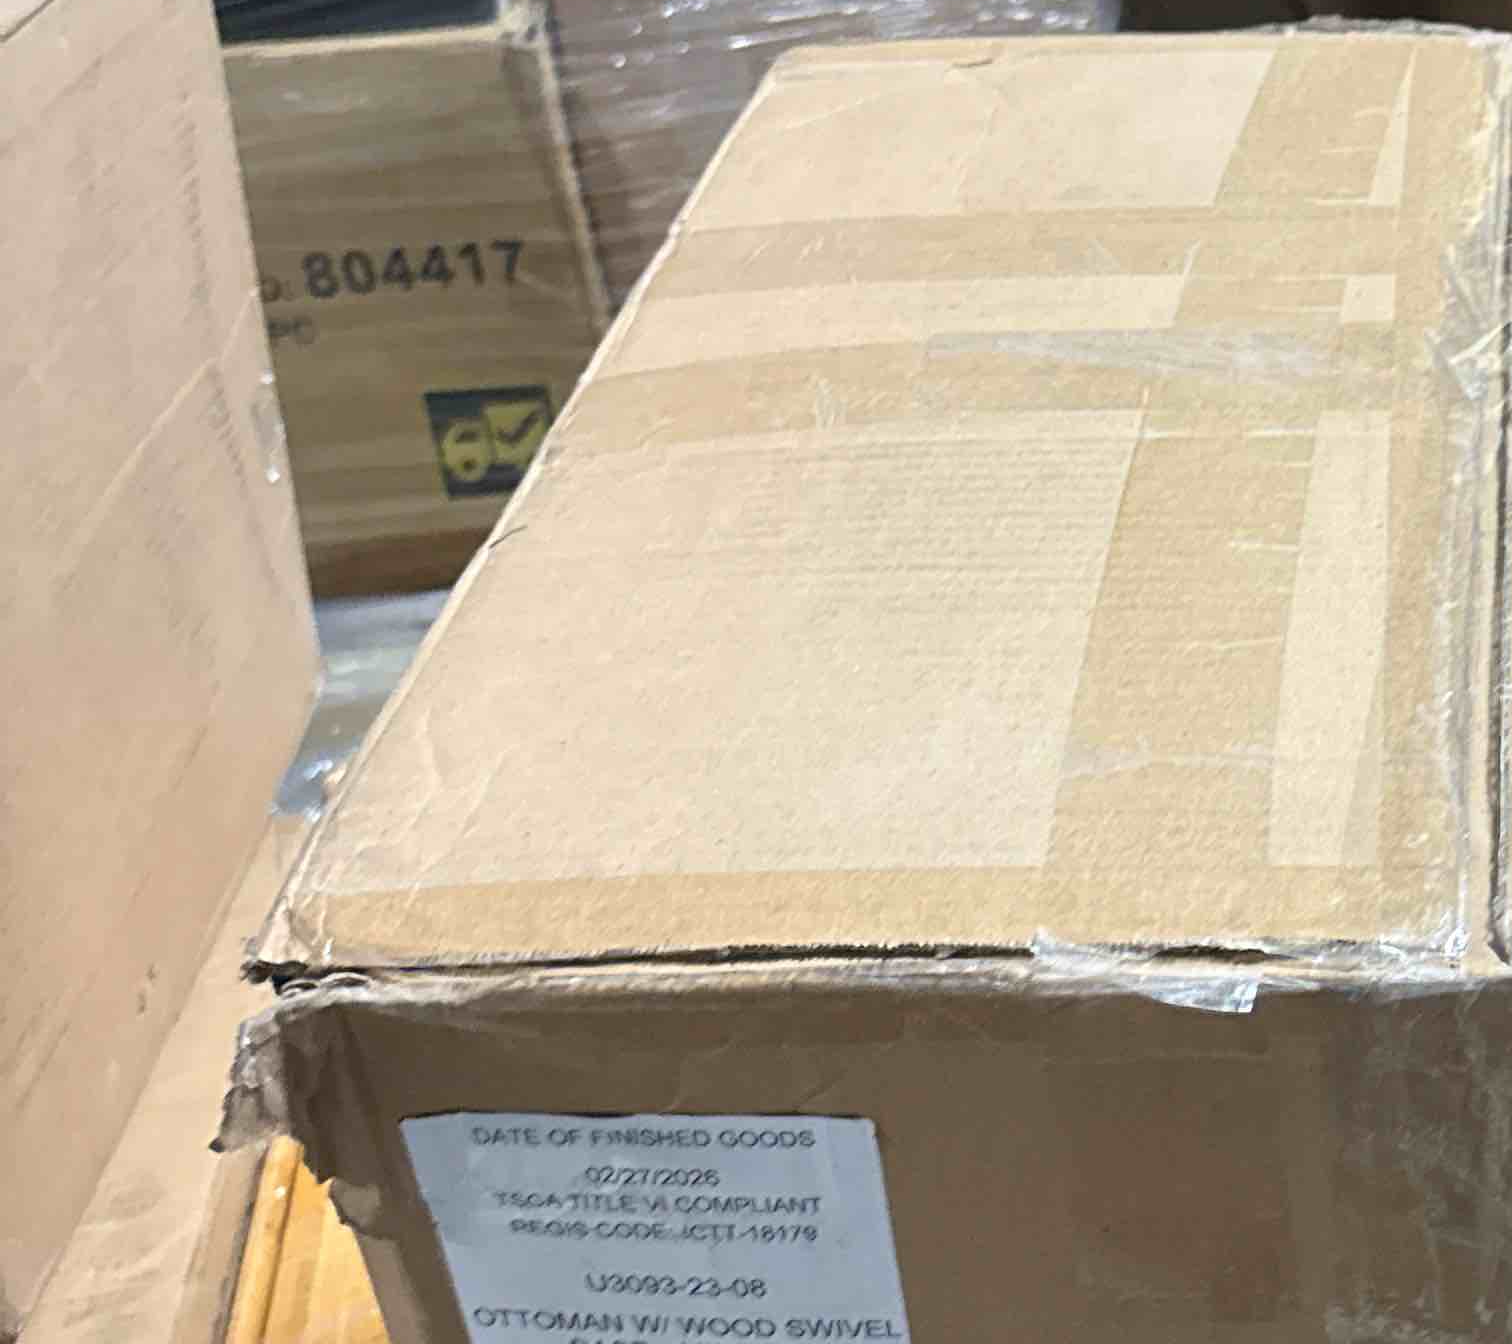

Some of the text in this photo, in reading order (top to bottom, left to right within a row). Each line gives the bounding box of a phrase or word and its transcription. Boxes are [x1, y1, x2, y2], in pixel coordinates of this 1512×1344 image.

[303, 239, 523, 299] 804417
[472, 1127, 816, 1148] DATE OF FINISHED GOODS
[674, 1197, 821, 1214] COMPLIANT
[585, 1273, 767, 1297] U3093-23-08
[473, 1307, 902, 1339] OTTOMAN W/ WOOD SWIVEL
